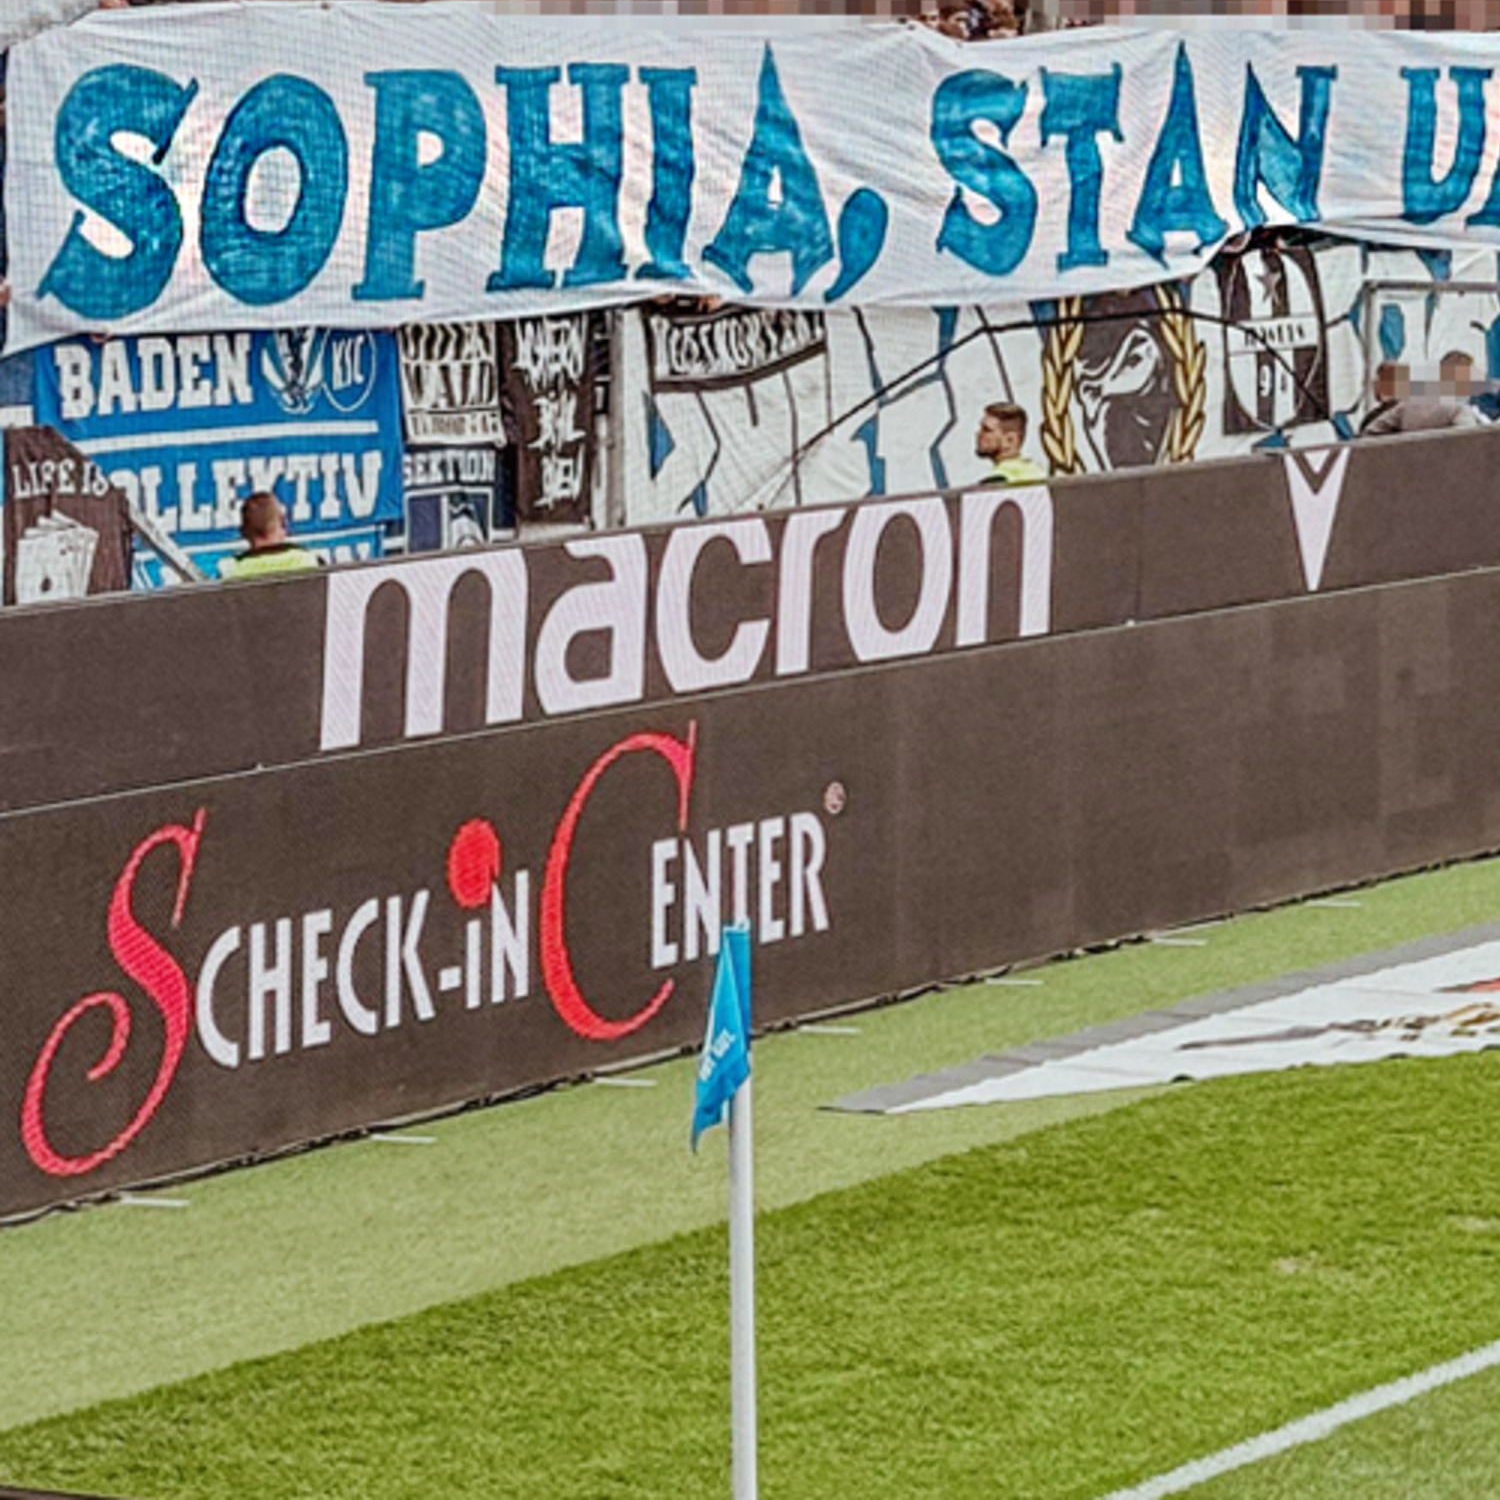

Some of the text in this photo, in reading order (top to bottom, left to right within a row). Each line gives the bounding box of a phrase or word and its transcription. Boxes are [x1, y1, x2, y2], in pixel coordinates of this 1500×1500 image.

[36, 38, 890, 320] SOPHIA,
[930, 40, 1338, 277] STAN
[55, 332, 253, 420] BADEN
[13, 458, 109, 499] LIFE IS
[109, 450, 382, 533] OLLEKTIV
[403, 449, 496, 487] SEKTION
[320, 483, 1055, 752] macron
